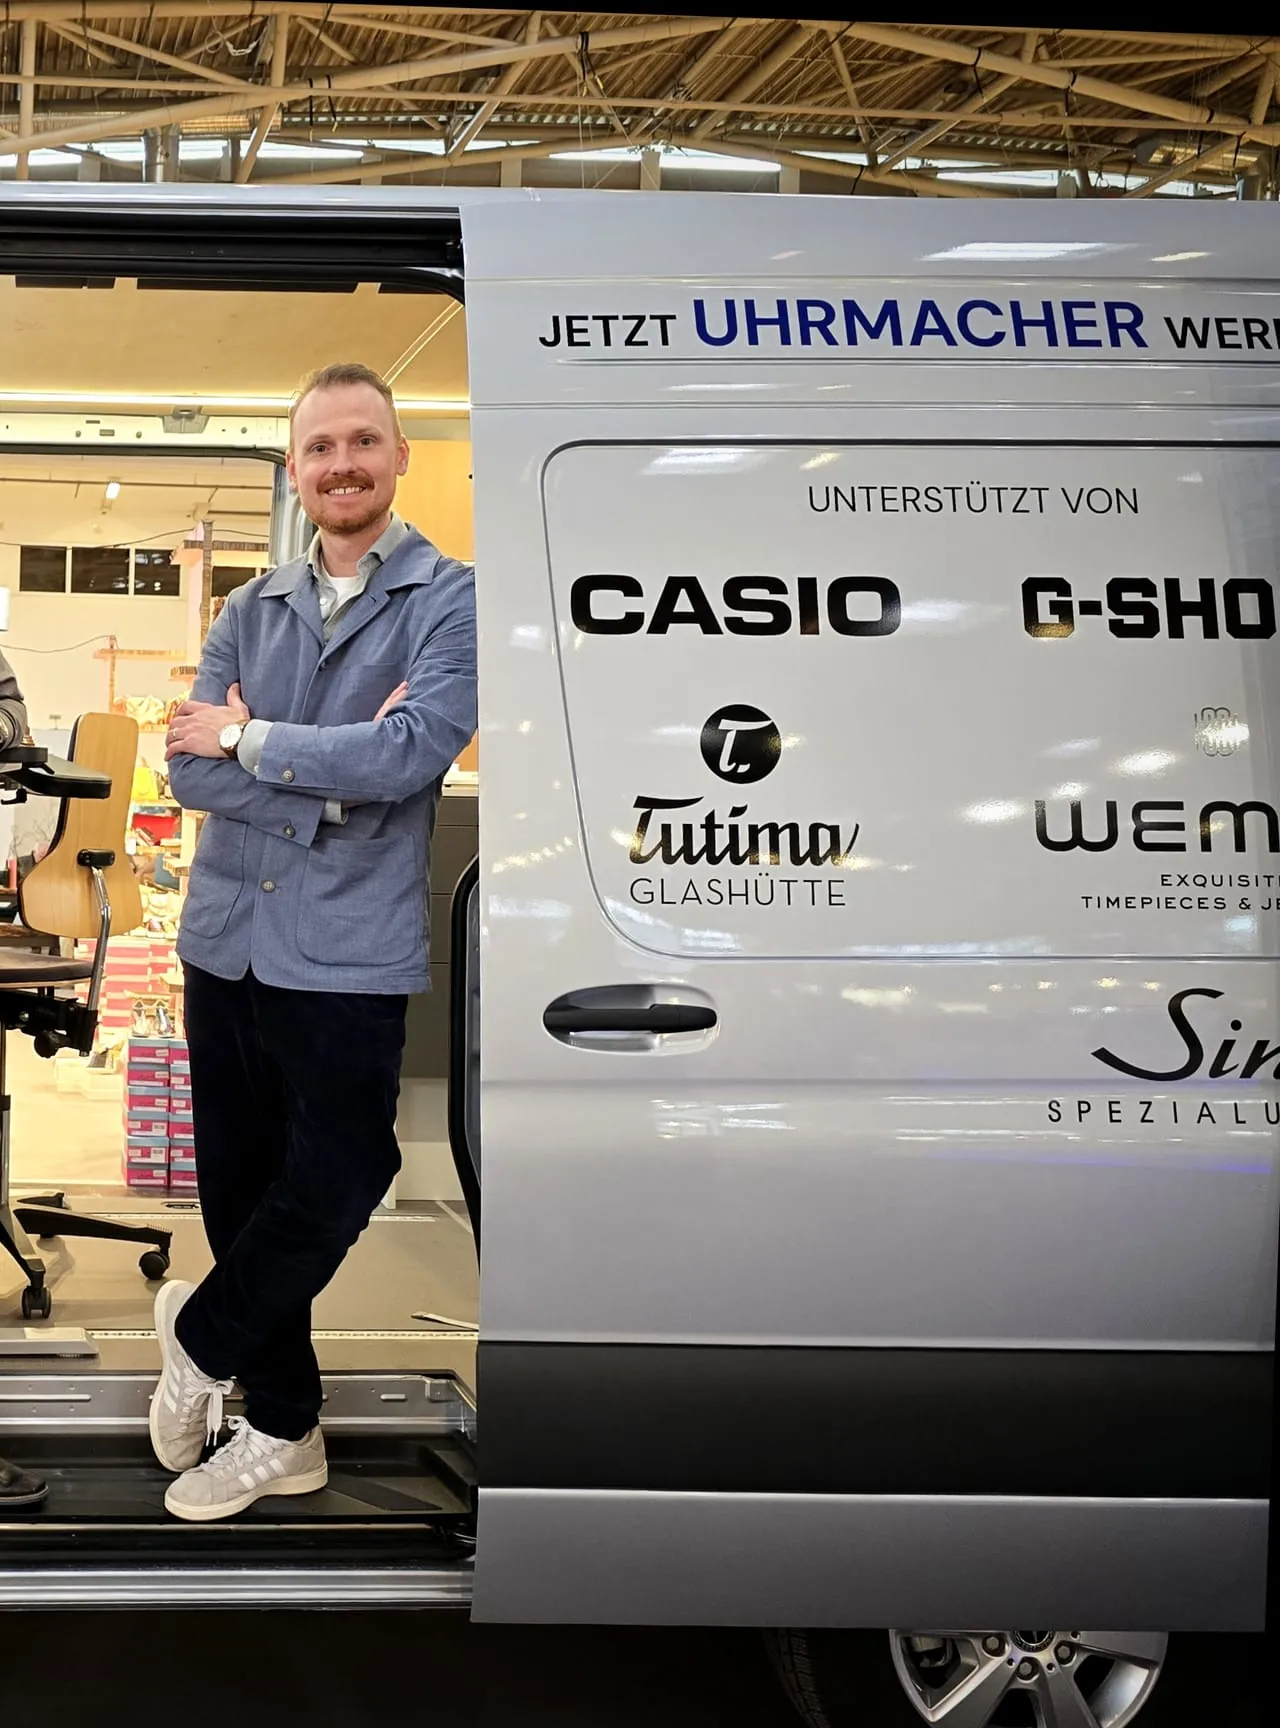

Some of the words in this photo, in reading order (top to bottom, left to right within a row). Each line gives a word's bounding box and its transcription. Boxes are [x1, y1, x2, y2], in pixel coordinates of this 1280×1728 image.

[539, 314, 677, 347] JETZT
[693, 298, 1148, 349] UHRMACHER
[808, 481, 1050, 514] UNTERSTÜTZT
[1060, 487, 1140, 514] VON
[570, 574, 902, 637] CASIO
[1021, 576, 1277, 640] G-SHO
[629, 795, 860, 866] Tutima
[629, 872, 847, 906] GLASHÜTTE
[1160, 873, 1280, 889] EXQUISIT
[1081, 896, 1227, 910] TIMEPIECES
[1238, 897, 1252, 911] &
[1047, 1099, 1280, 1125] SPEZIALU
